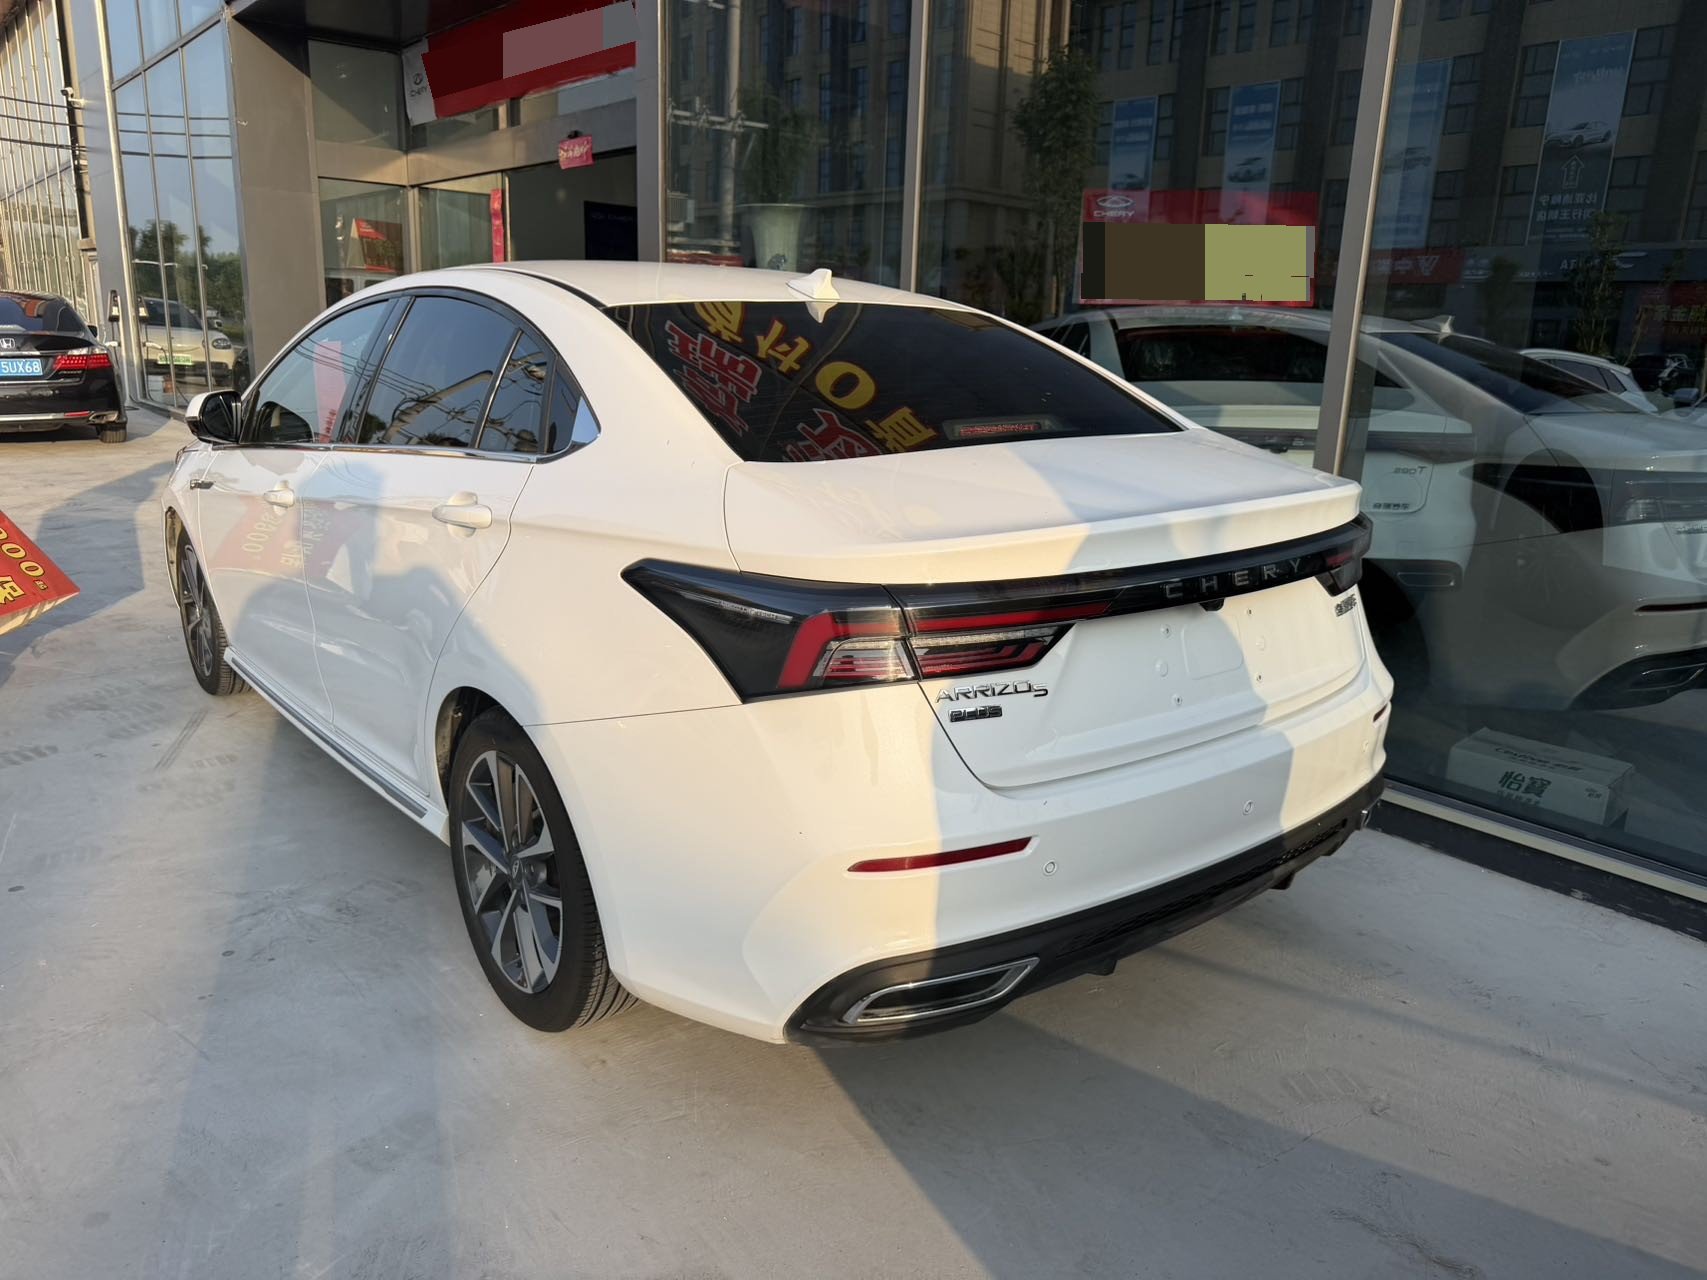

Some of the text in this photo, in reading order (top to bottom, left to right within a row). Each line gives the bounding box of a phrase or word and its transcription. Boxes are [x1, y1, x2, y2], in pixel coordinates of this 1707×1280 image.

[1093, 209, 1135, 218] CHERY
[1, 361, 40, 373] 5UX68
[1165, 558, 1301, 599] CHERY
